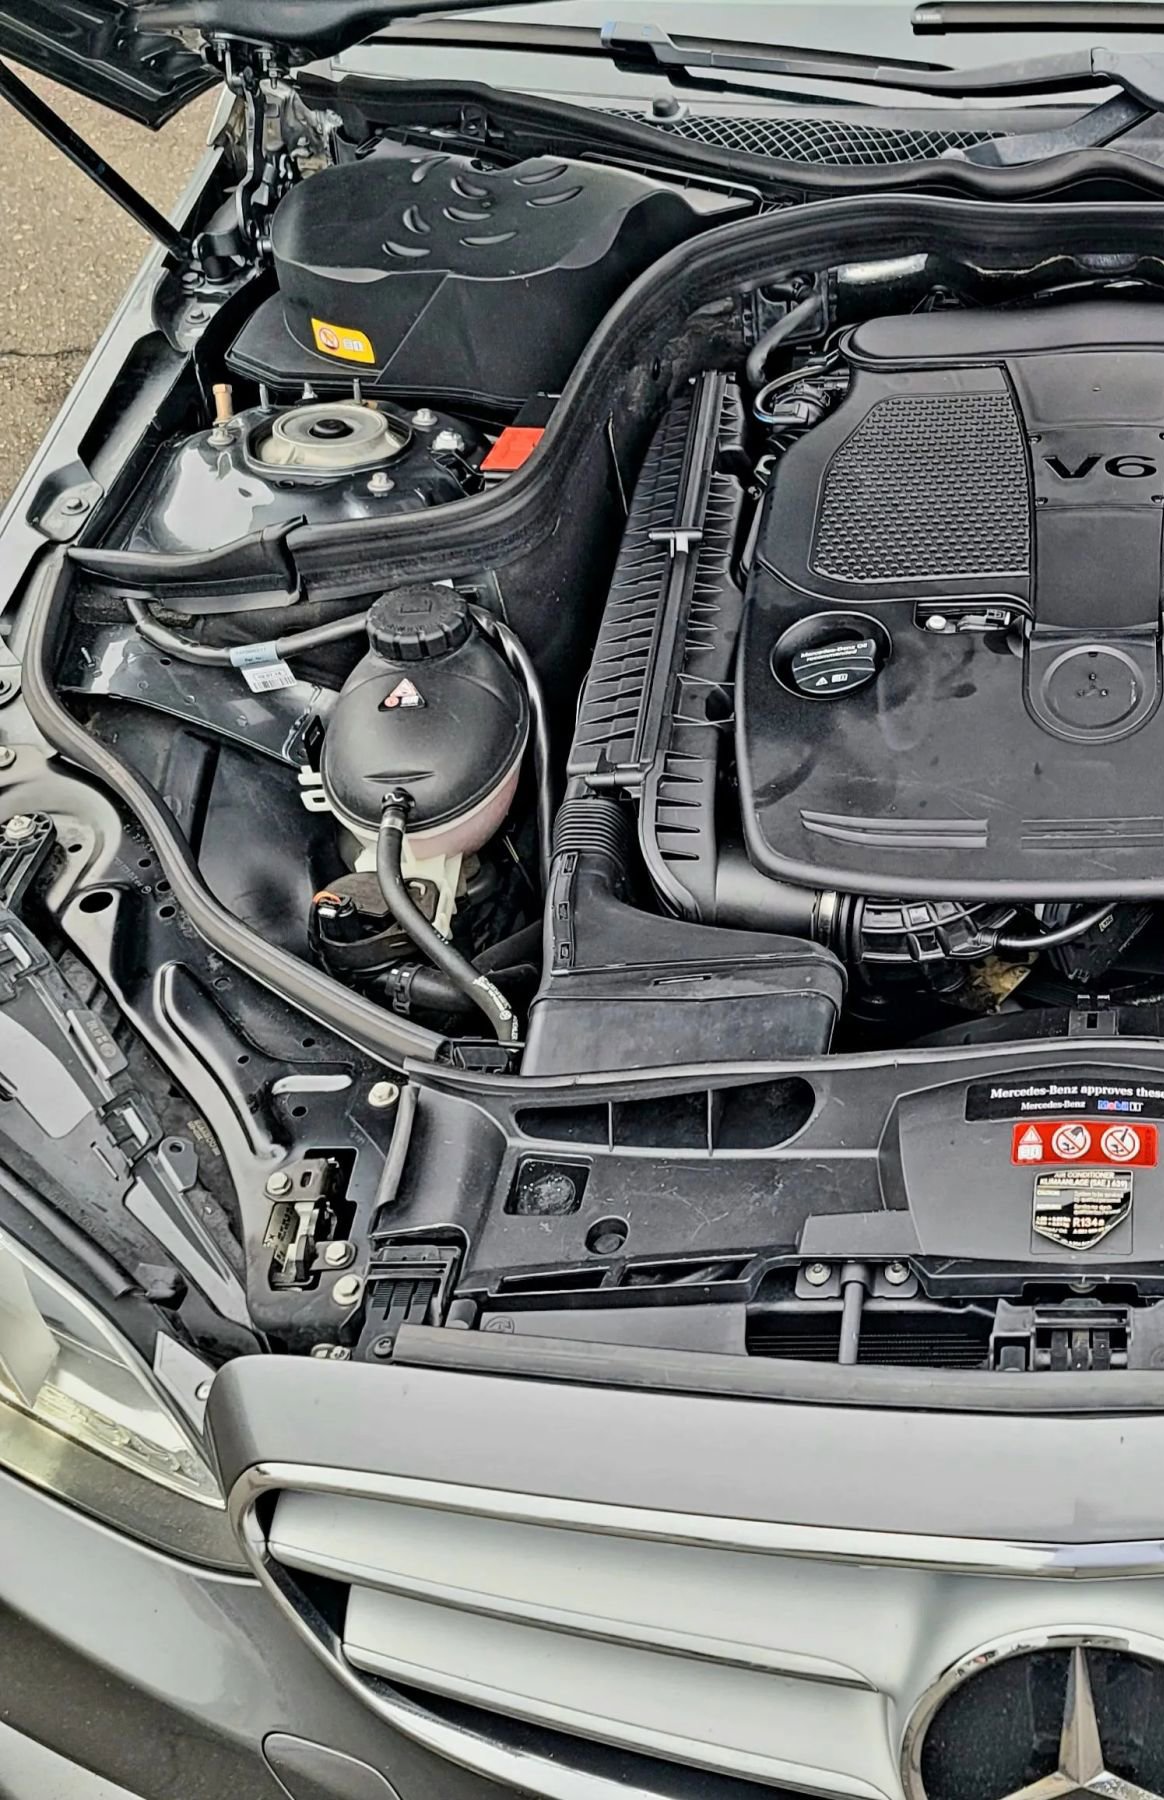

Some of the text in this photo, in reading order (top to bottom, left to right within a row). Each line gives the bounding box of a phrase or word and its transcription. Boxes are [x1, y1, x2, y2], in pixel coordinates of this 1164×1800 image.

[1041, 453, 1157, 480] V6
[990, 1084, 1079, 1099] Mercedes-Benz
[1080, 1085, 1133, 1097] approves
[1020, 1099, 1086, 1111] Mercedes-Benz
[1097, 1099, 1128, 1111] Mobil
